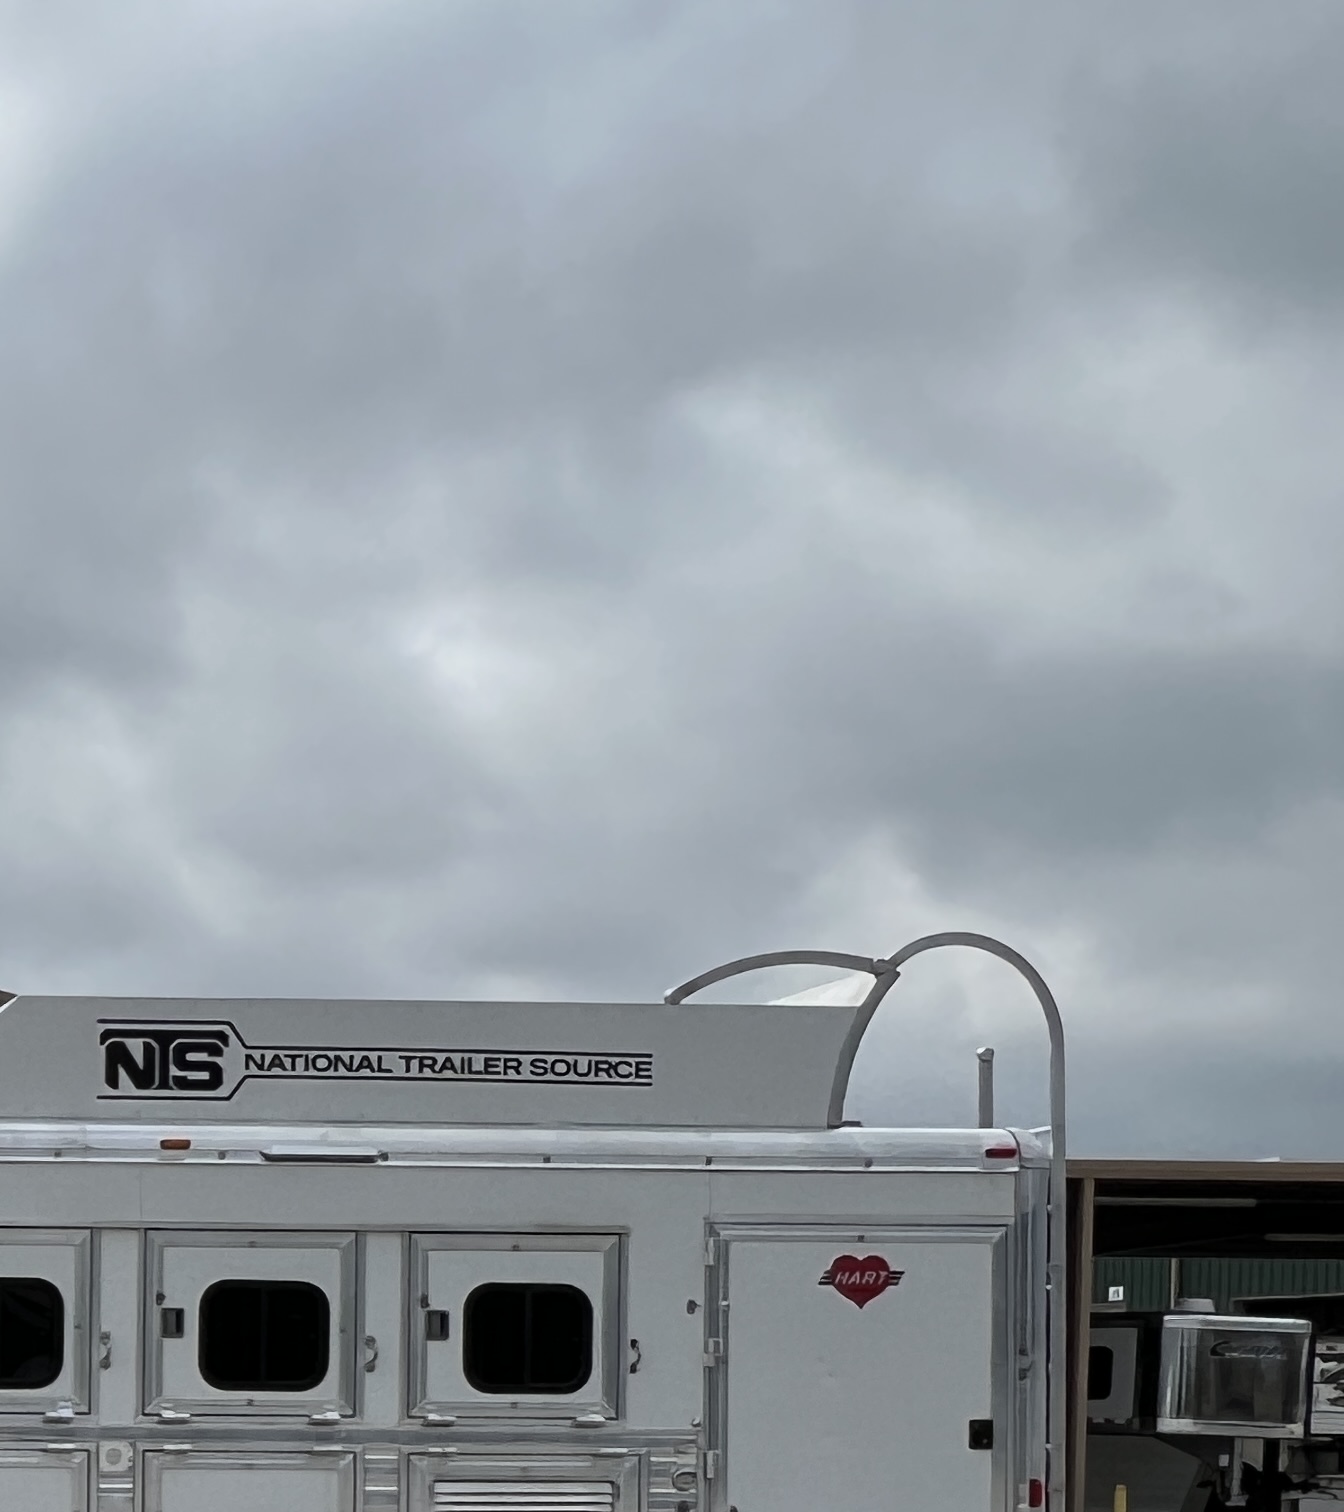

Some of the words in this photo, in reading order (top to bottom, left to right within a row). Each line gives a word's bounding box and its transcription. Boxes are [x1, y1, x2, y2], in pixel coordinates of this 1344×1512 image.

[99, 1028, 229, 1091] NTS
[244, 1053, 393, 1073] NATIONAL
[398, 1054, 522, 1076] TRAILER
[529, 1058, 653, 1080] SOURCE
[834, 1270, 889, 1285] HART
